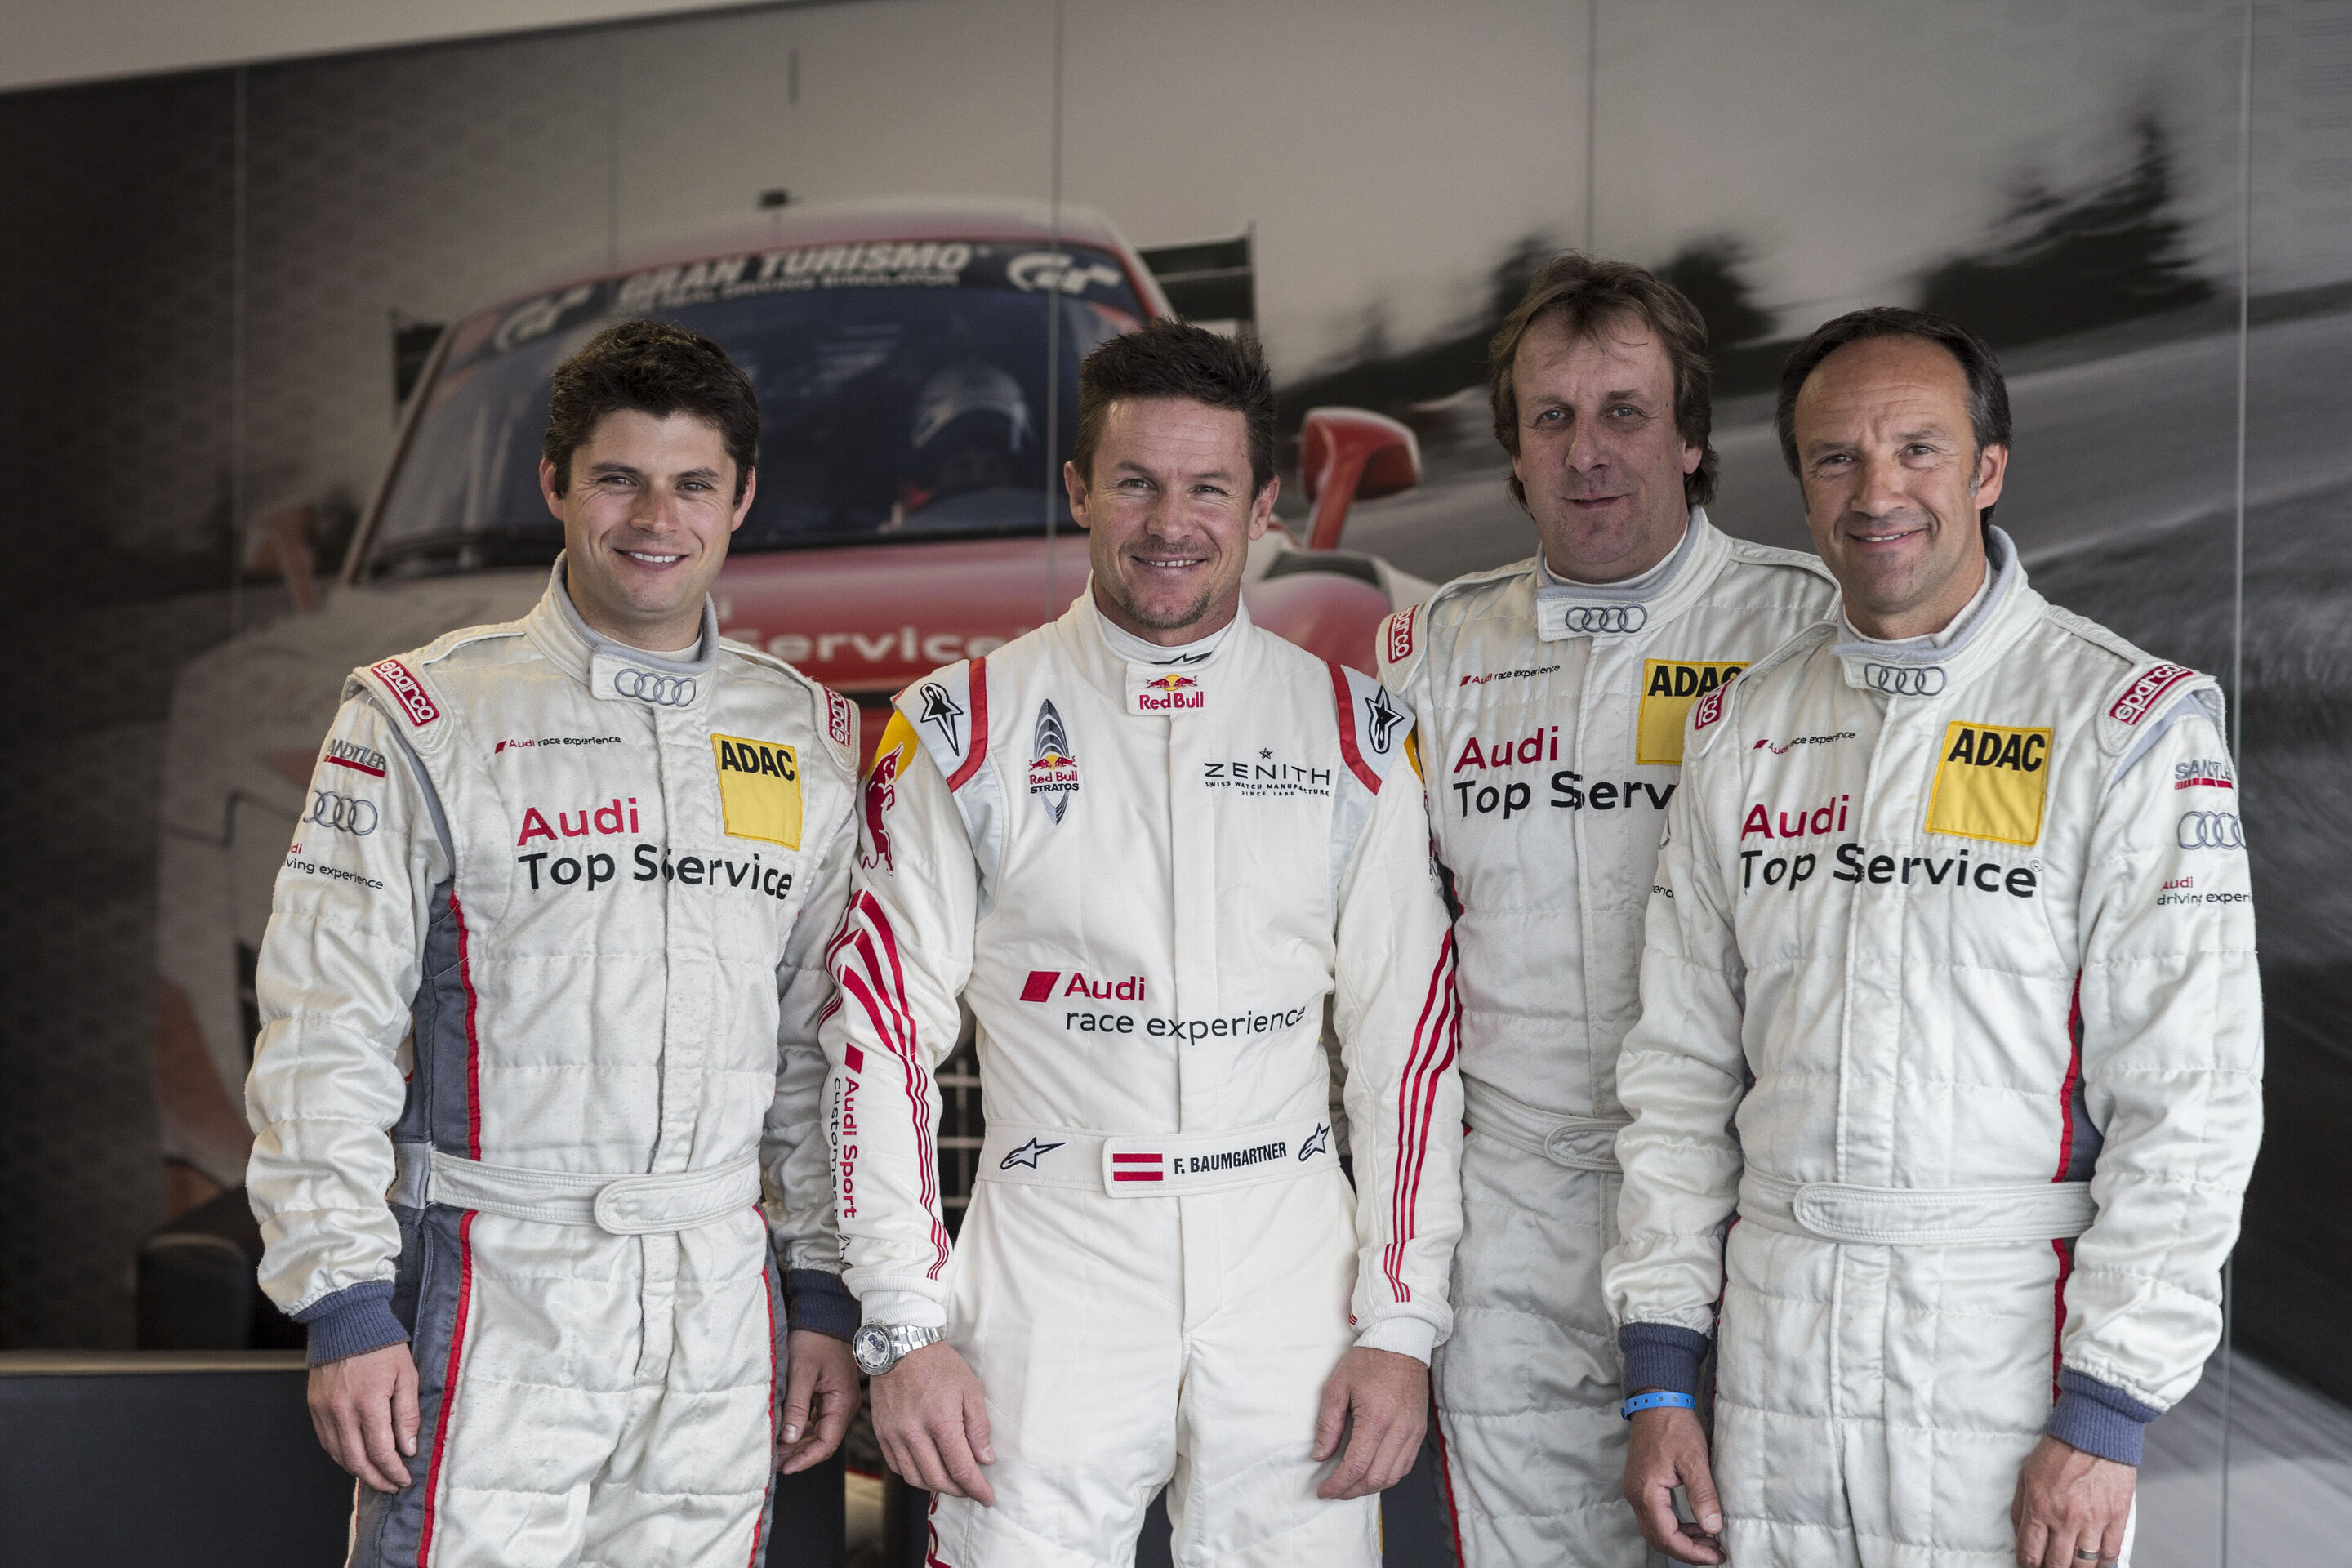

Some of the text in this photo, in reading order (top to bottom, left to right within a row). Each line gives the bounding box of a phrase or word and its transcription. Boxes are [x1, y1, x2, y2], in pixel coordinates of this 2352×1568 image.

[618, 243, 972, 299] GRAN TURISMO
[378, 662, 434, 722] sparco
[1472, 665, 1561, 684] Audi race experience
[2114, 665, 2185, 721] sparco
[1139, 690, 1204, 710] Red Bull
[509, 736, 621, 748] Audi race experience
[721, 740, 795, 781] ADAC
[1453, 726, 1558, 773] Audi
[1947, 728, 2045, 772] ADAC
[1029, 770, 1078, 785] Red Bull
[1030, 783, 1080, 794] STRATOS
[1205, 762, 1330, 786] ZENITH
[1235, 781, 1263, 790] WATCH
[1267, 783, 1330, 796] MANUFACTURE
[1453, 780, 1531, 820] Top
[1741, 795, 1849, 841] Audi
[517, 797, 639, 846] Audi
[319, 866, 384, 889] experience
[518, 844, 794, 900] Top Service
[1741, 843, 2038, 898] Top Service
[2161, 876, 2193, 892] Audi
[1063, 973, 1145, 1001] Audi
[1066, 1006, 1306, 1045] race experience
[842, 1076, 860, 1136] Audi
[1174, 1142, 1288, 1174] F. BAUMGARTNER
[840, 1144, 858, 1218] Sport
